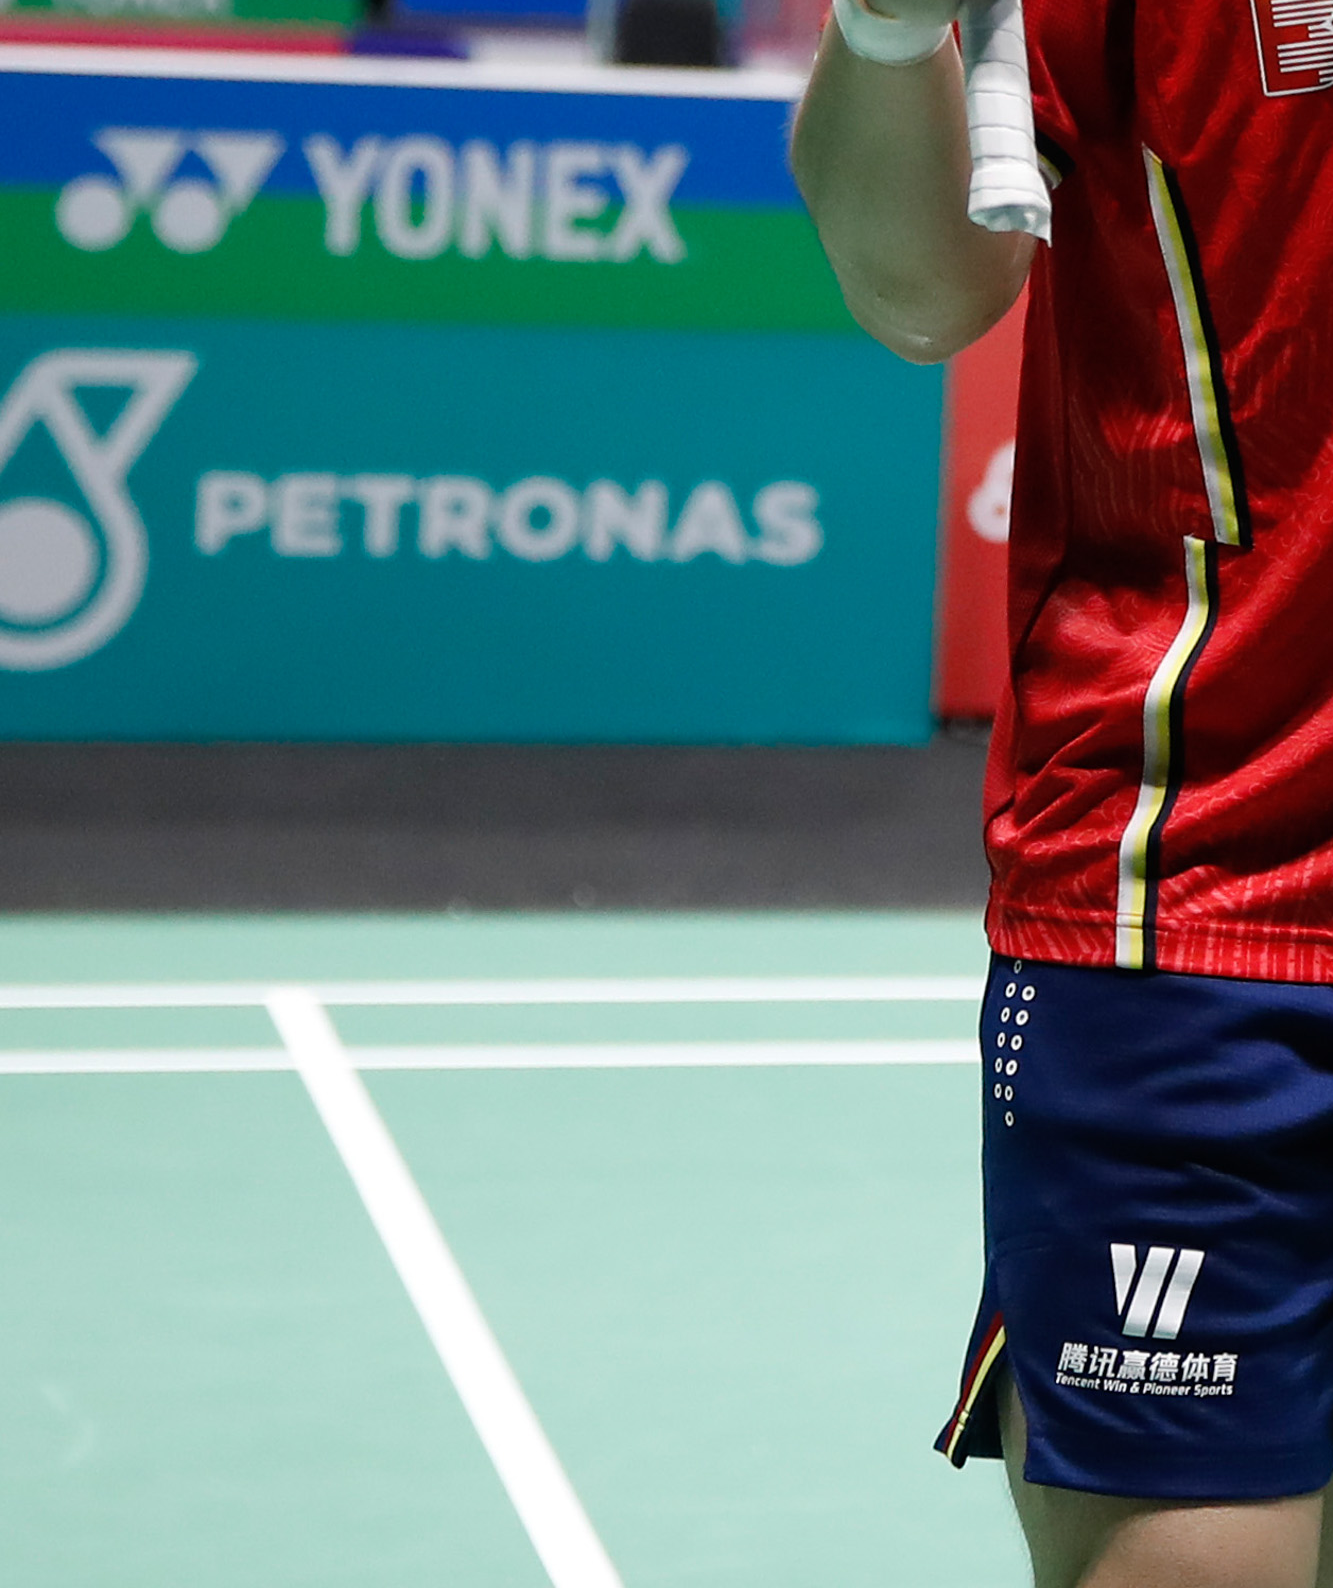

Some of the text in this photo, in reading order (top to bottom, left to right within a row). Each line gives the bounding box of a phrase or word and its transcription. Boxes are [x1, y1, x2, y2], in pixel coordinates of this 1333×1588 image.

[303, 132, 690, 264] YONEX
[196, 468, 823, 567] PETRONAS
[1055, 1372, 1234, 1398] Tencent Win & Pioneer Sports
[1057, 1342, 1239, 1384] 腾讯赢德体育
